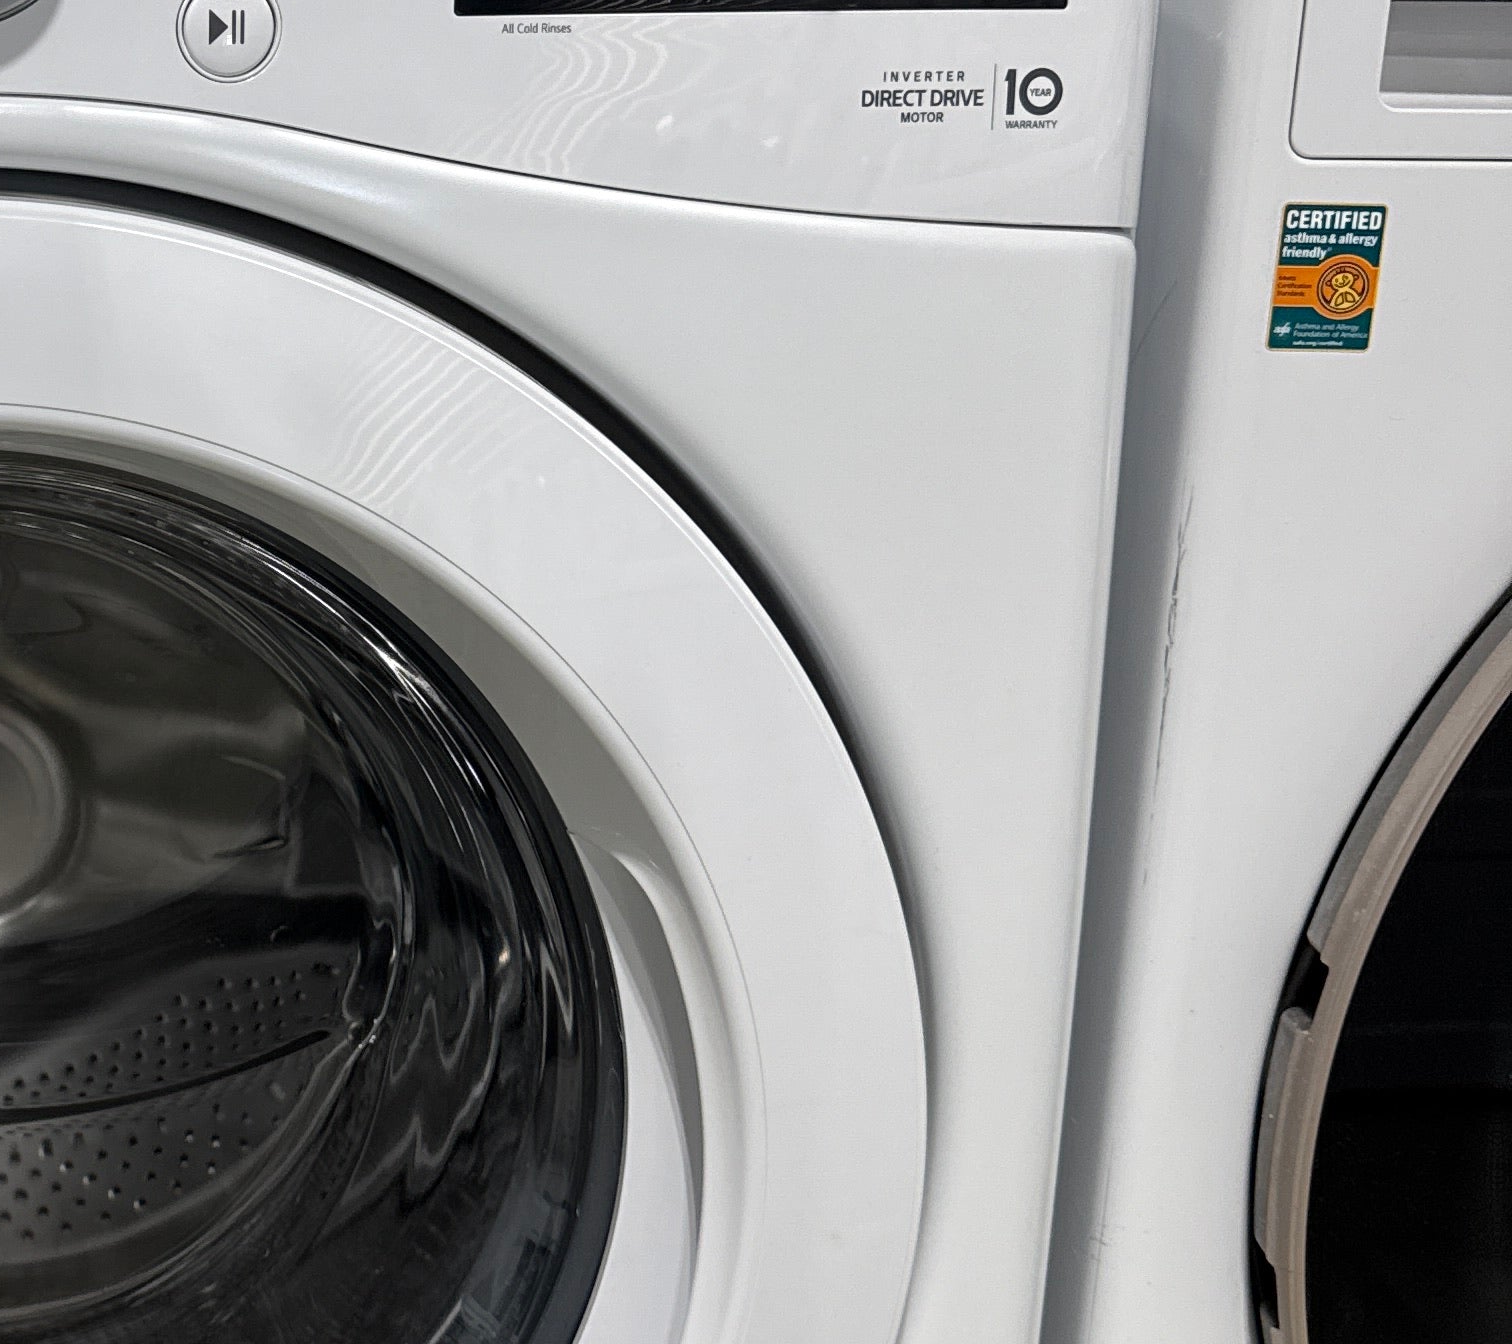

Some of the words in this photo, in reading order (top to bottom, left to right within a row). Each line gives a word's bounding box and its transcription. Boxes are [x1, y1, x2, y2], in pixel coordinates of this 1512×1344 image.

[501, 23, 515, 34] All
[517, 23, 539, 34] Cold
[541, 23, 572, 34] Rinses
[883, 71, 965, 82] INVERTER
[1004, 67, 1063, 116] 10
[1030, 88, 1052, 97] YEAR
[861, 89, 926, 107] DIRECT
[930, 89, 984, 106] DRIVE
[900, 112, 944, 123] MOTOR
[1005, 120, 1058, 129] WARRANTY
[1286, 209, 1383, 230] CERTIFIED
[1284, 232, 1327, 244] asthma
[1328, 233, 1337, 245] &
[1338, 232, 1378, 247] allergy
